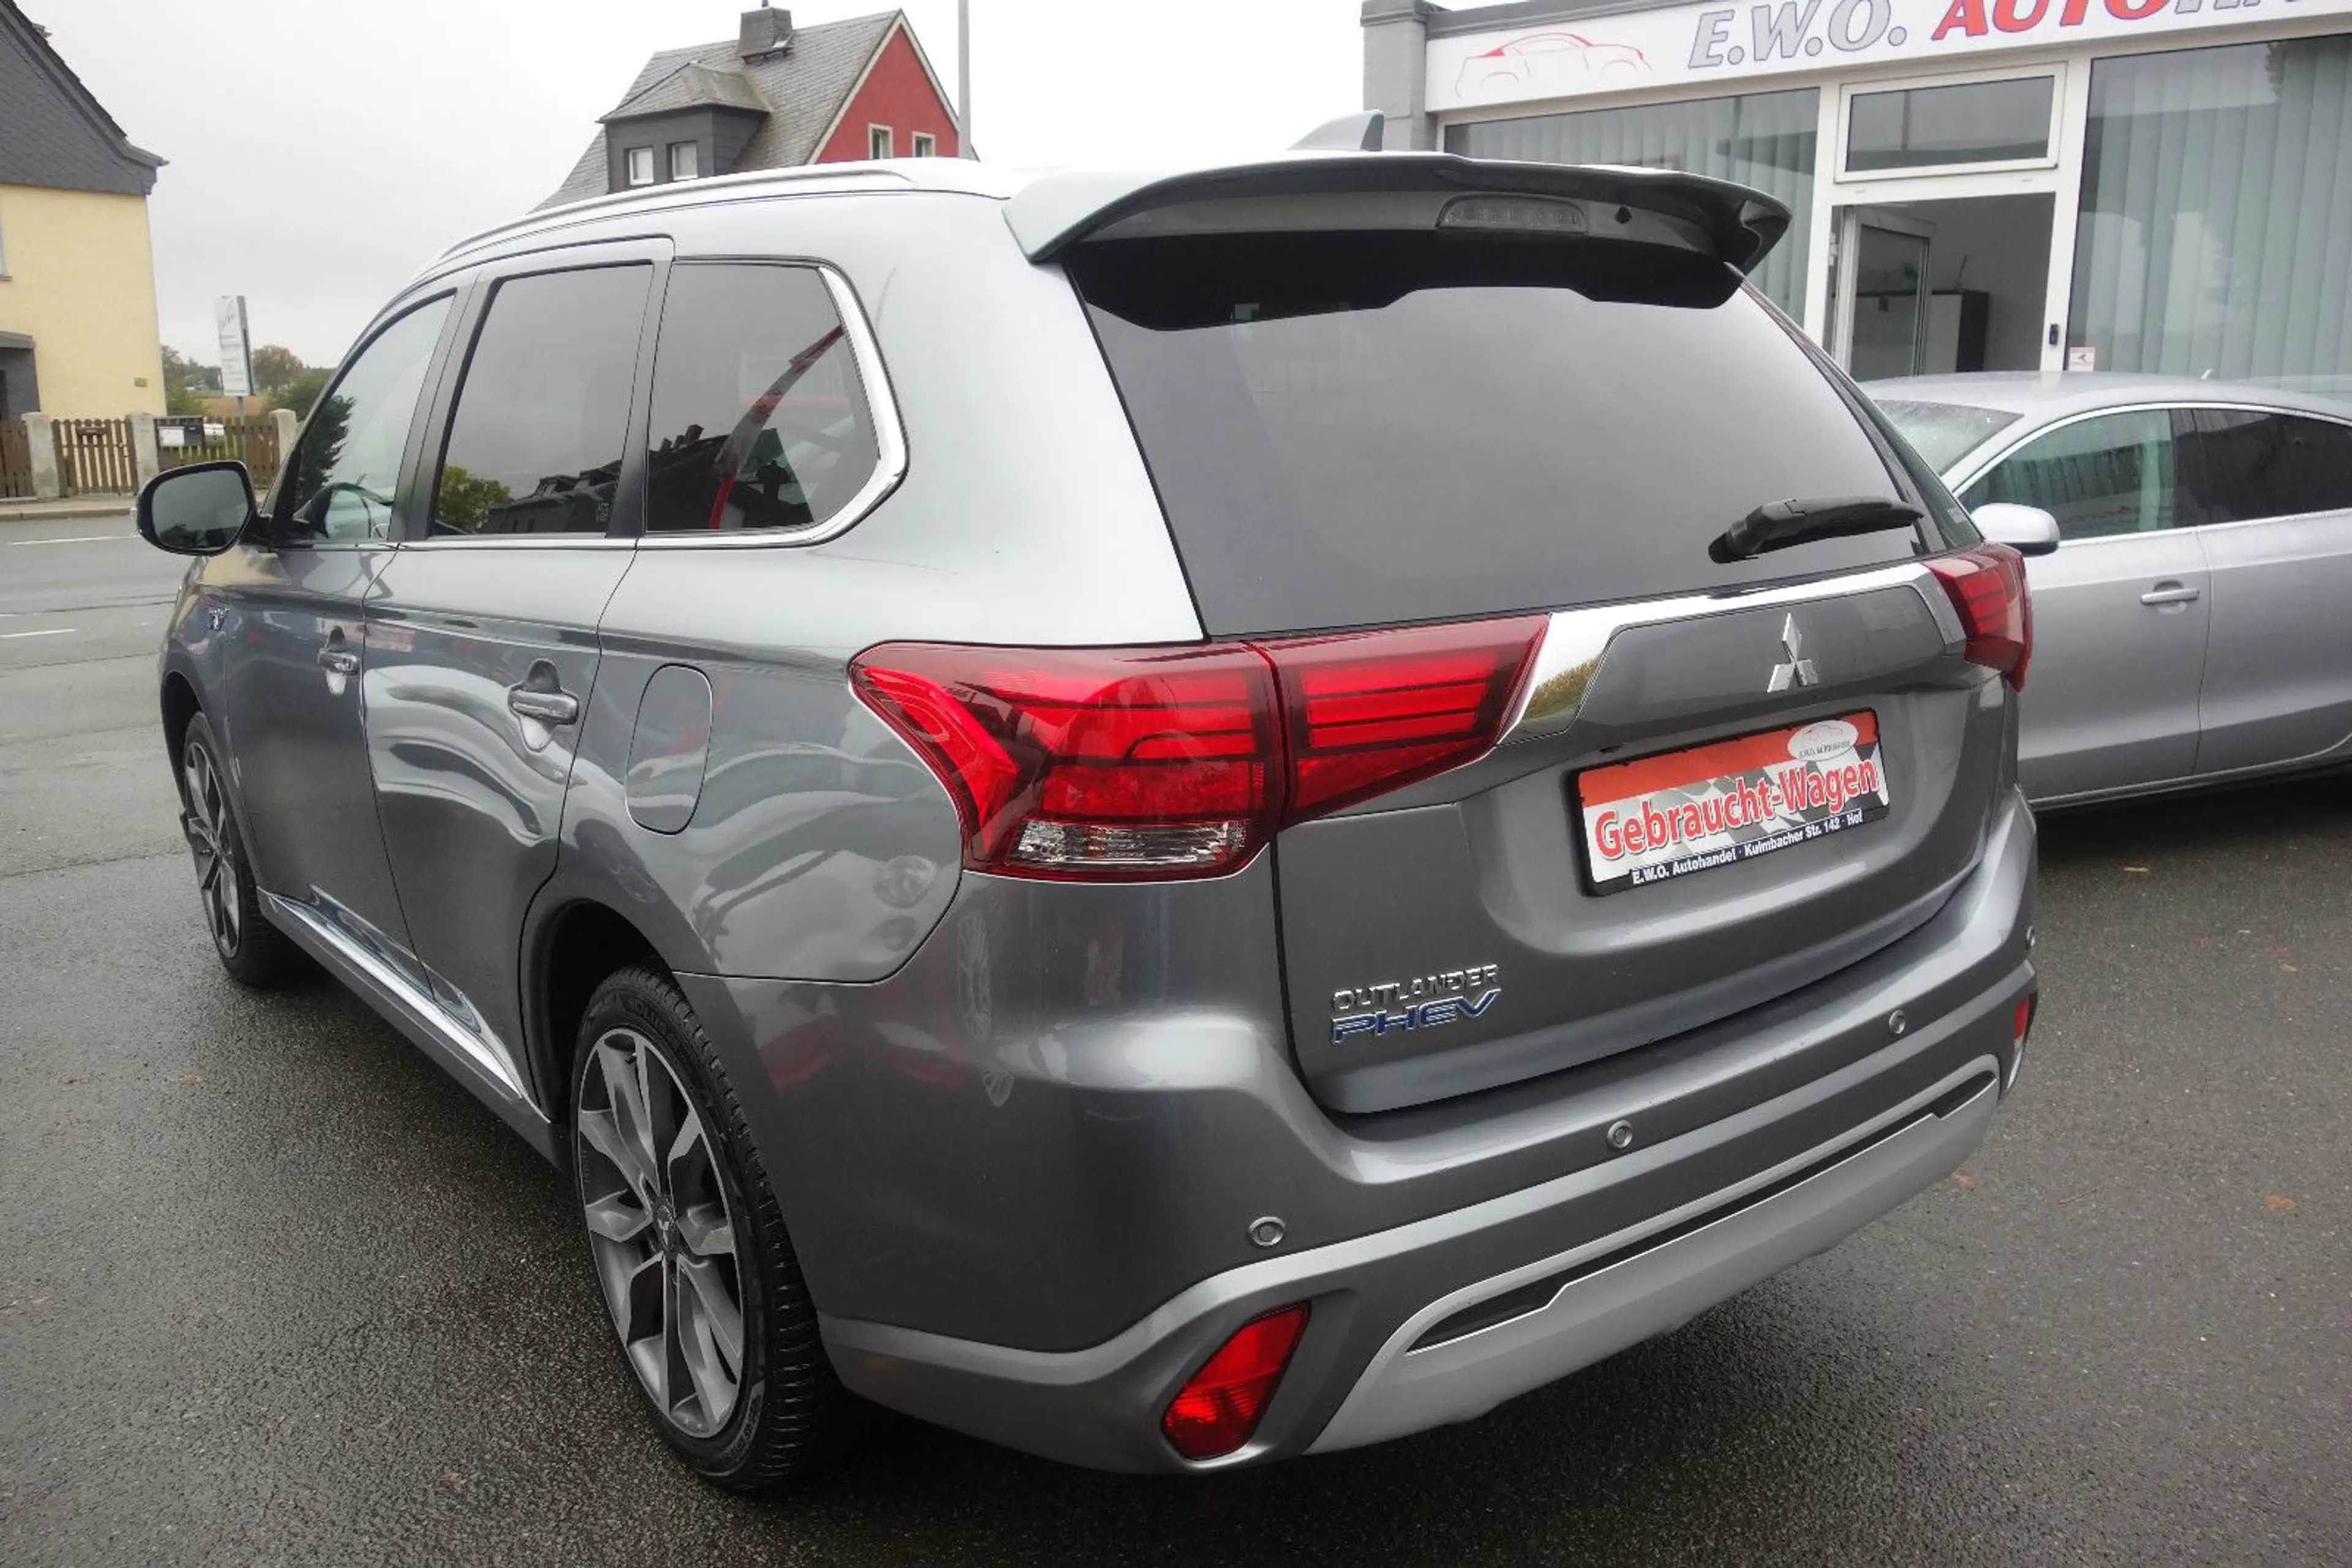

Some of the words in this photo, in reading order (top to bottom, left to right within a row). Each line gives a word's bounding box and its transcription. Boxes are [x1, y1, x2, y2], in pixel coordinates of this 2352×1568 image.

[1688, 0, 1907, 69] E.W.O.
[1594, 758, 1880, 861] Gebraucht-Wagen
[1632, 865, 1670, 885] E.W.O.
[1673, 847, 1737, 875] Autohandel
[1744, 829, 1804, 857] Kulmbacher
[1805, 824, 1822, 839] Str.
[1823, 816, 1841, 832] 142
[1846, 810, 1863, 826] Hof
[1332, 963, 1501, 1011] OUTLANDER
[1332, 987, 1502, 1045] PHEV
